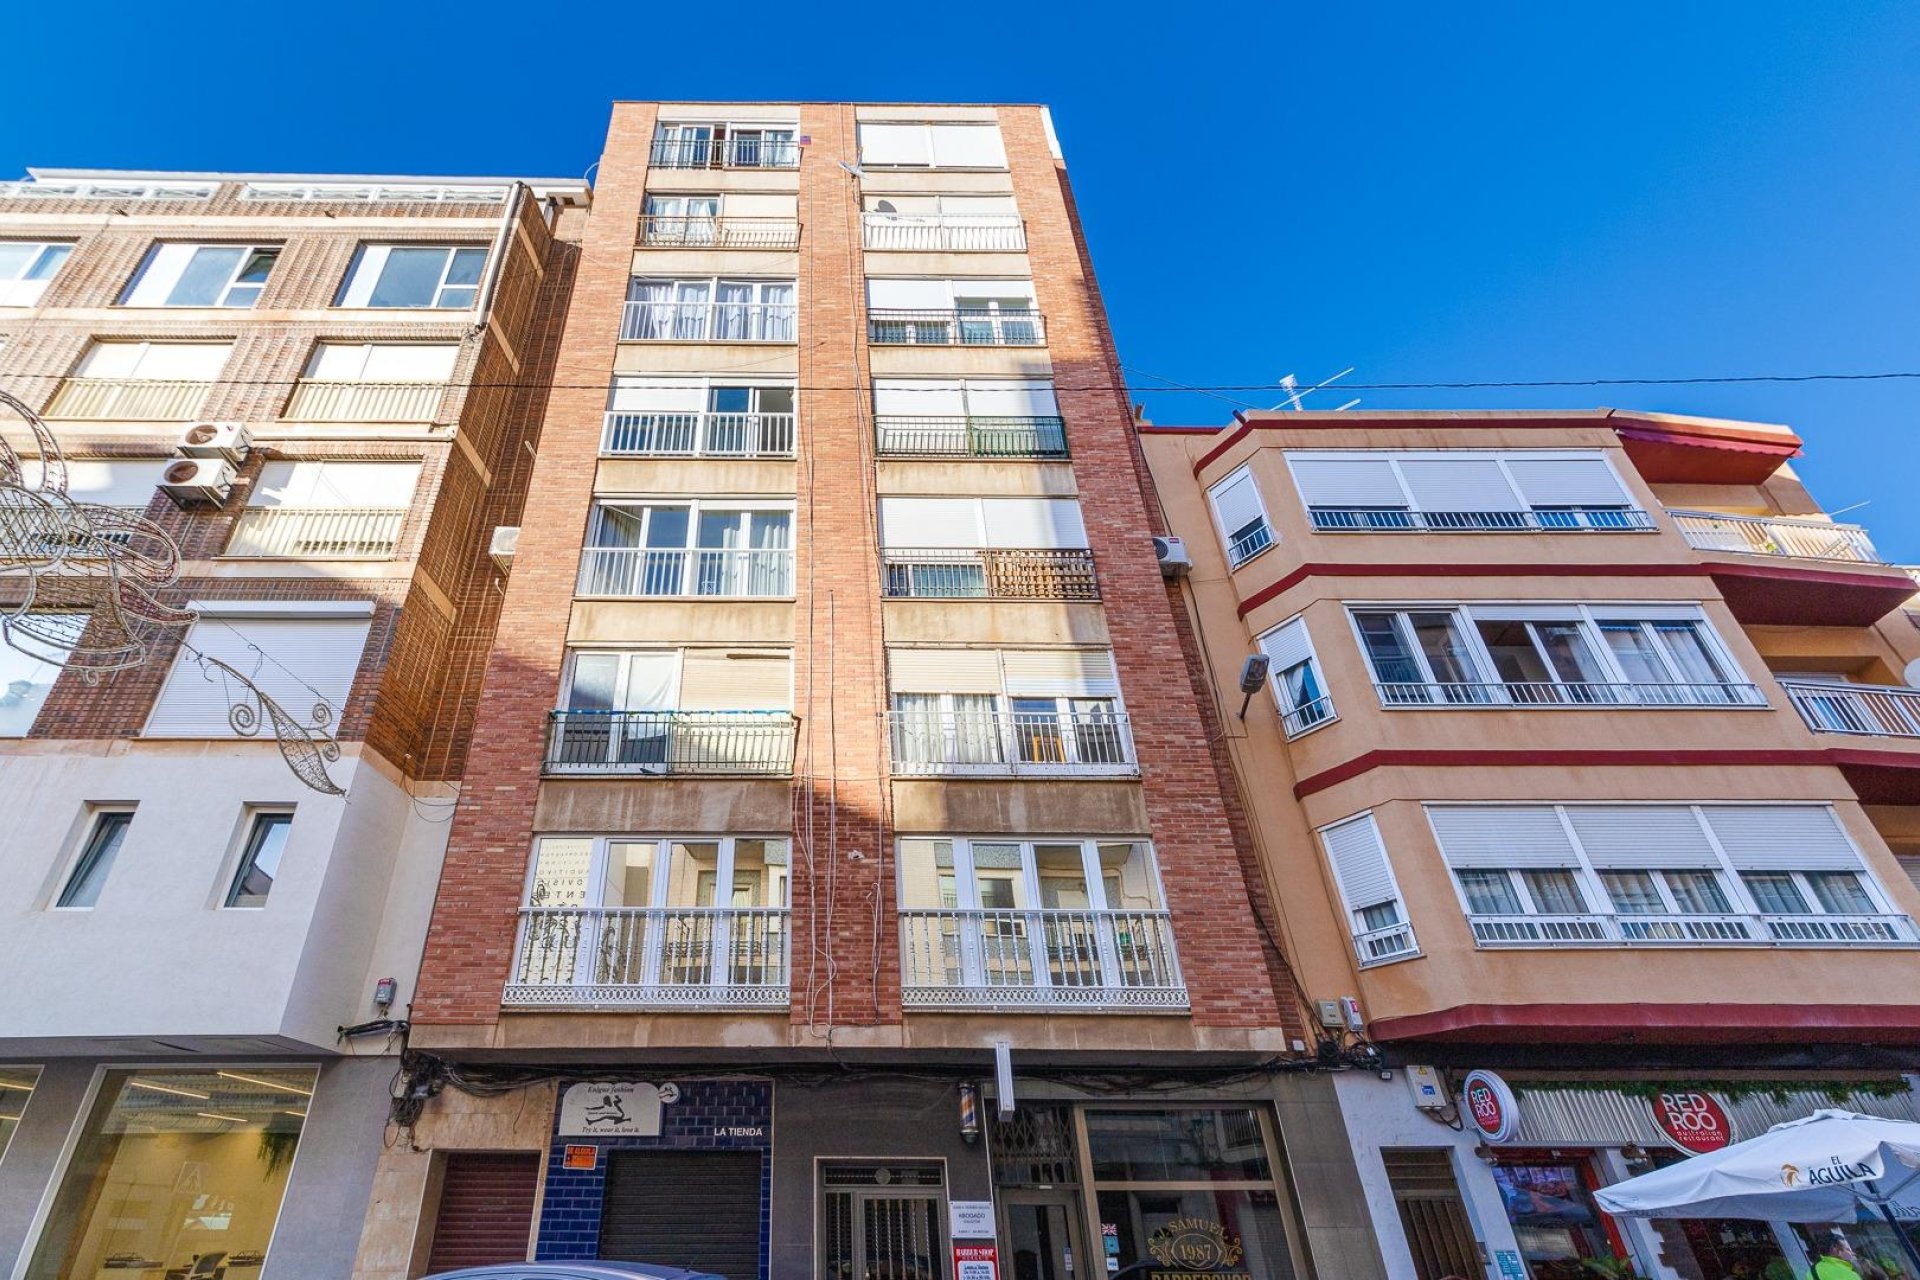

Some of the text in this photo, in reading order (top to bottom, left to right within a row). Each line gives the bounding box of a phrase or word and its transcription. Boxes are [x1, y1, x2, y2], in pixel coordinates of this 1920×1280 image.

[1470, 1088, 1492, 1104] RED
[1660, 1093, 1708, 1112] RED
[1475, 1101, 1497, 1118] ROO
[1668, 1112, 1717, 1131] ROO
[714, 1127, 763, 1136] LA TIENDA
[1830, 1156, 1842, 1165] EL
[1807, 1162, 1877, 1186] ÁGUILA
[1180, 1238, 1212, 1260] 1987
